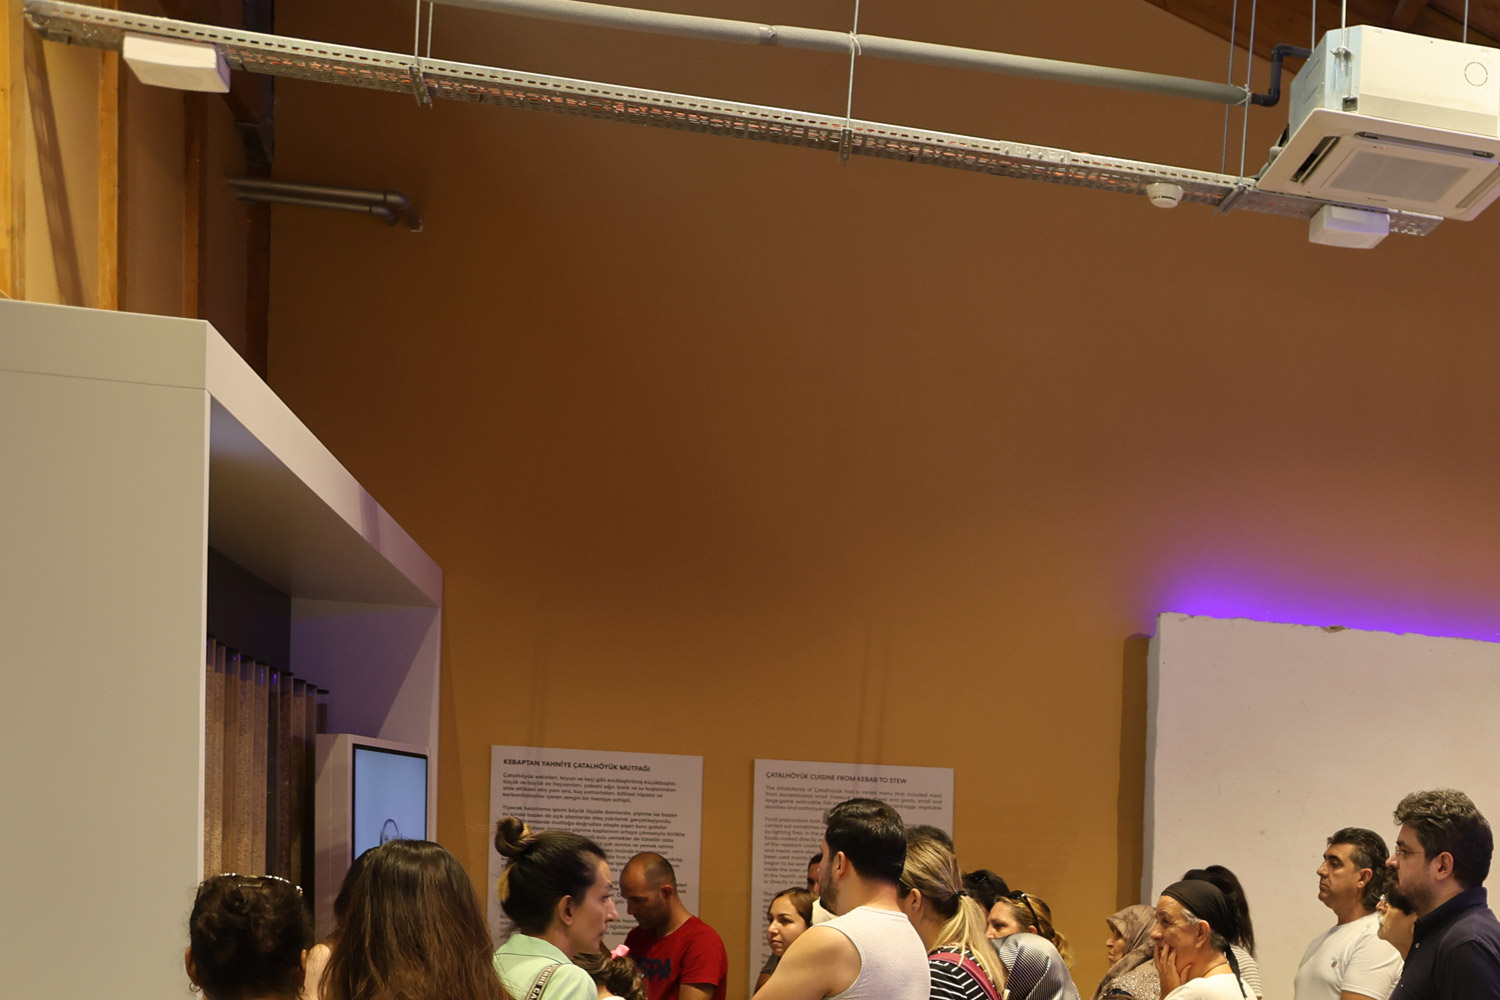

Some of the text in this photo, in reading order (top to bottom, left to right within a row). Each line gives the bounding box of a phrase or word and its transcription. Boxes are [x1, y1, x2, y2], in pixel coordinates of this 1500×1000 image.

[503, 758, 650, 772] KEBAPTAN YAHNİYE ÇATALHÖYÜK MUTFAĞI
[766, 771, 808, 780] ÇATALHÖYÜK
[810, 773, 835, 781] CUISINE
